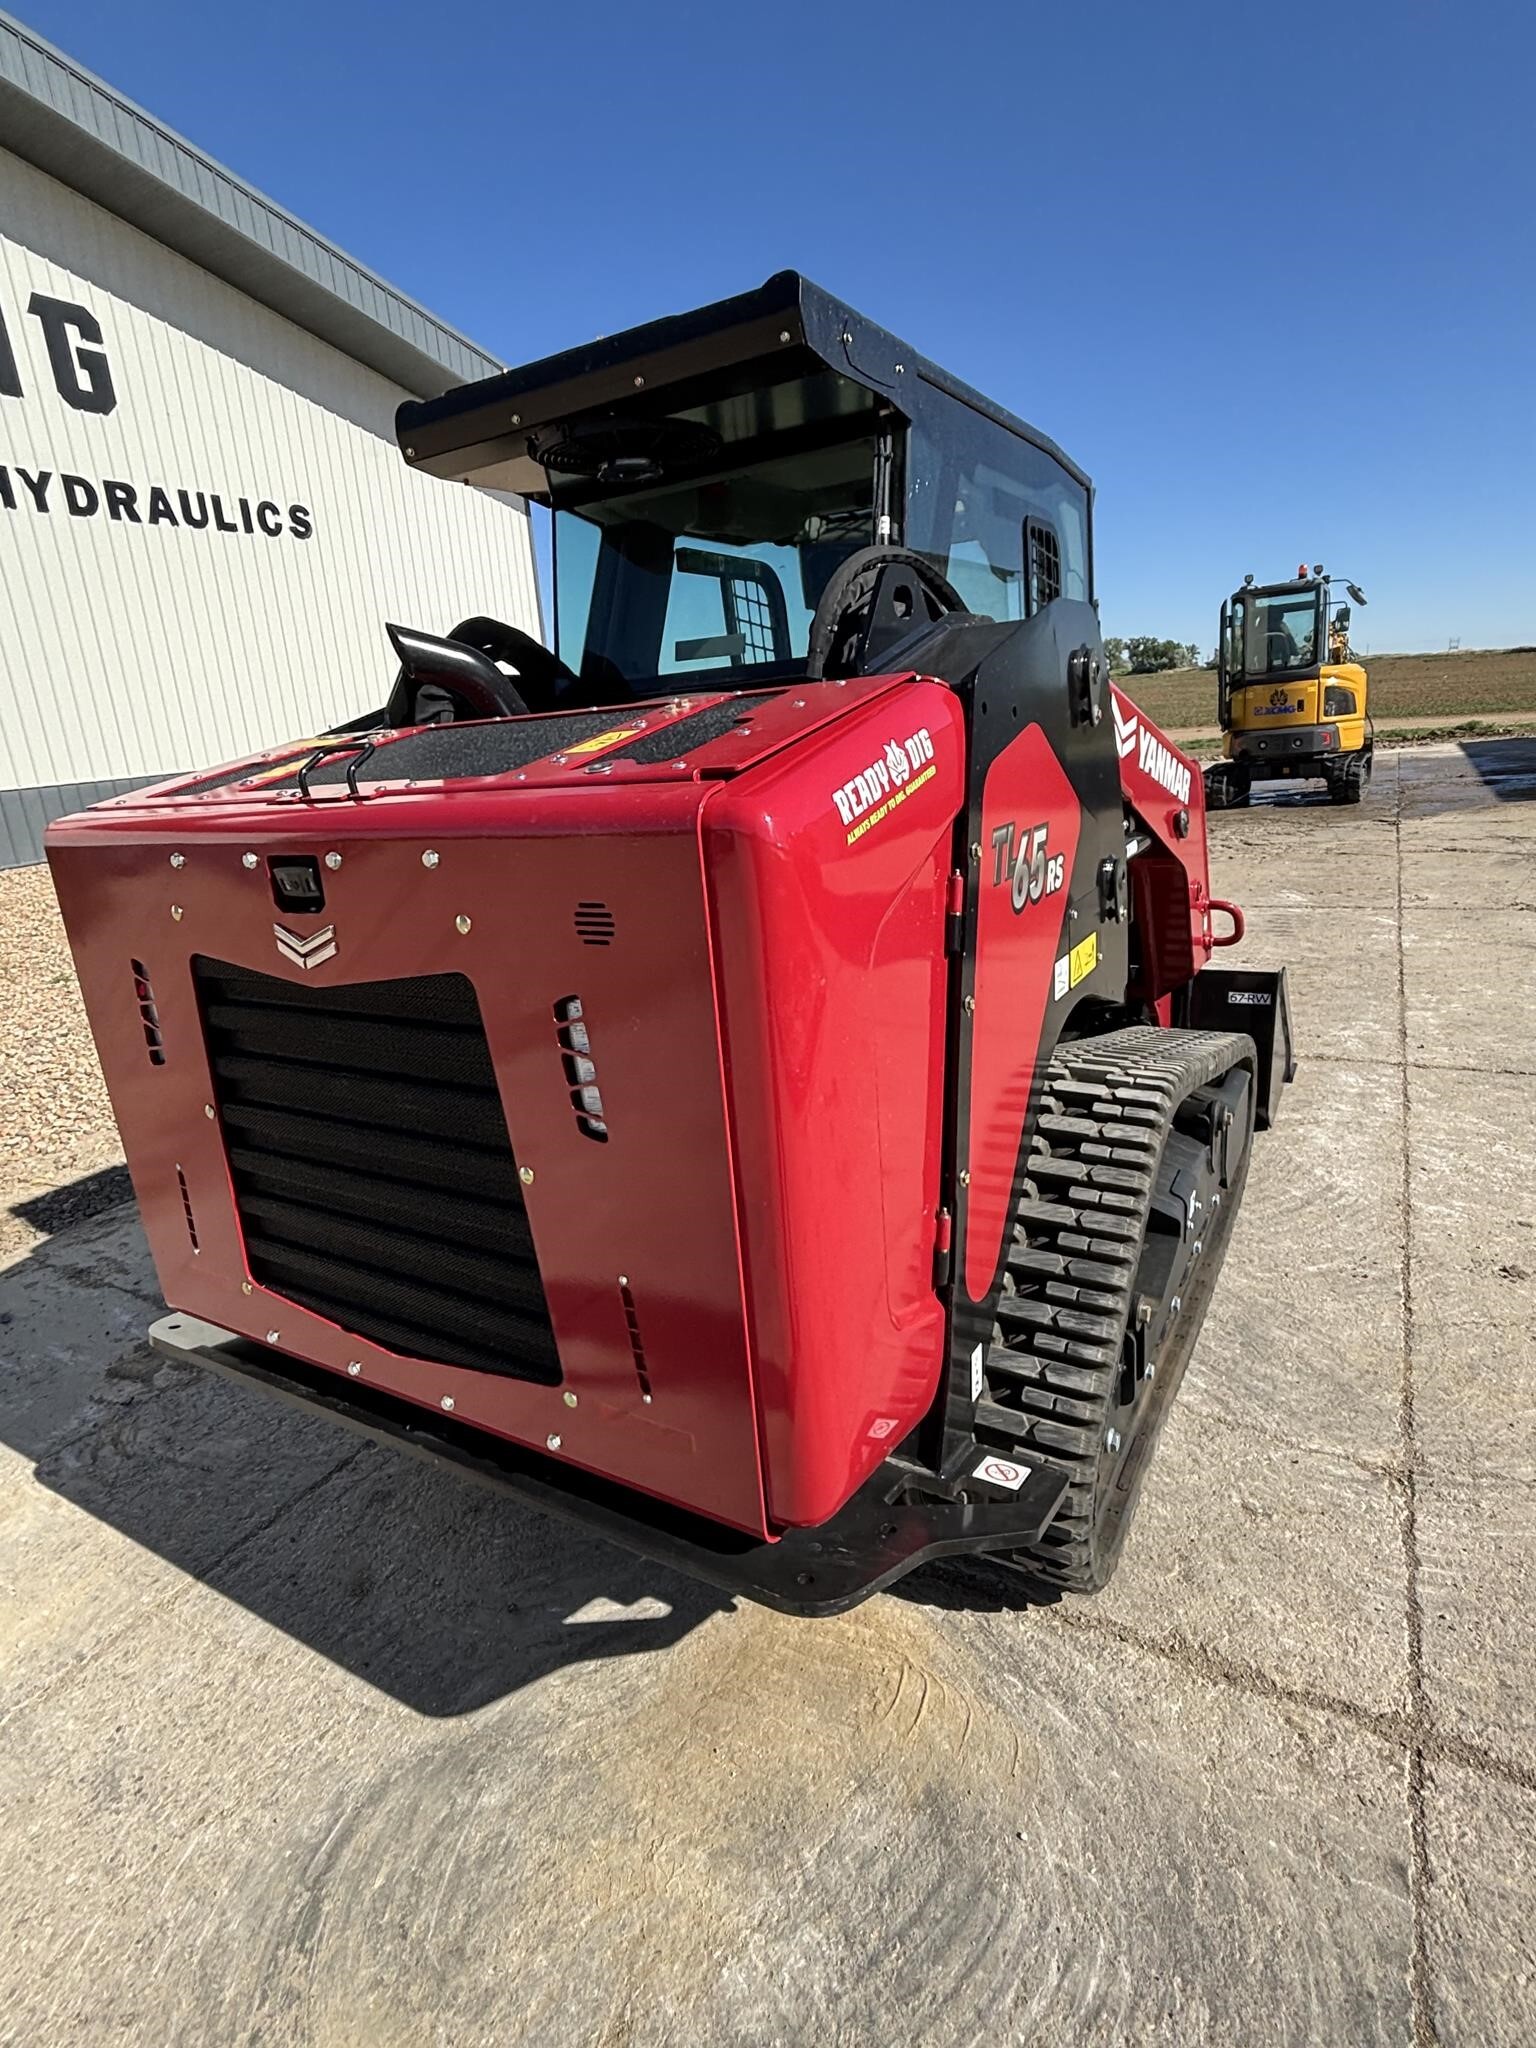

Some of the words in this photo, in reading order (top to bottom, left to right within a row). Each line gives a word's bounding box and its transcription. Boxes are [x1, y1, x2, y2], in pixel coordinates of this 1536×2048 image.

[0, 291, 117, 416] G
[832, 759, 891, 826] READY
[903, 727, 935, 771] DIG
[1139, 724, 1192, 806] YANMAR
[846, 818, 871, 846] ALWAYS
[869, 803, 888, 827] READY
[887, 797, 897, 811] TO
[1229, 993, 1270, 1004] 67-RW
